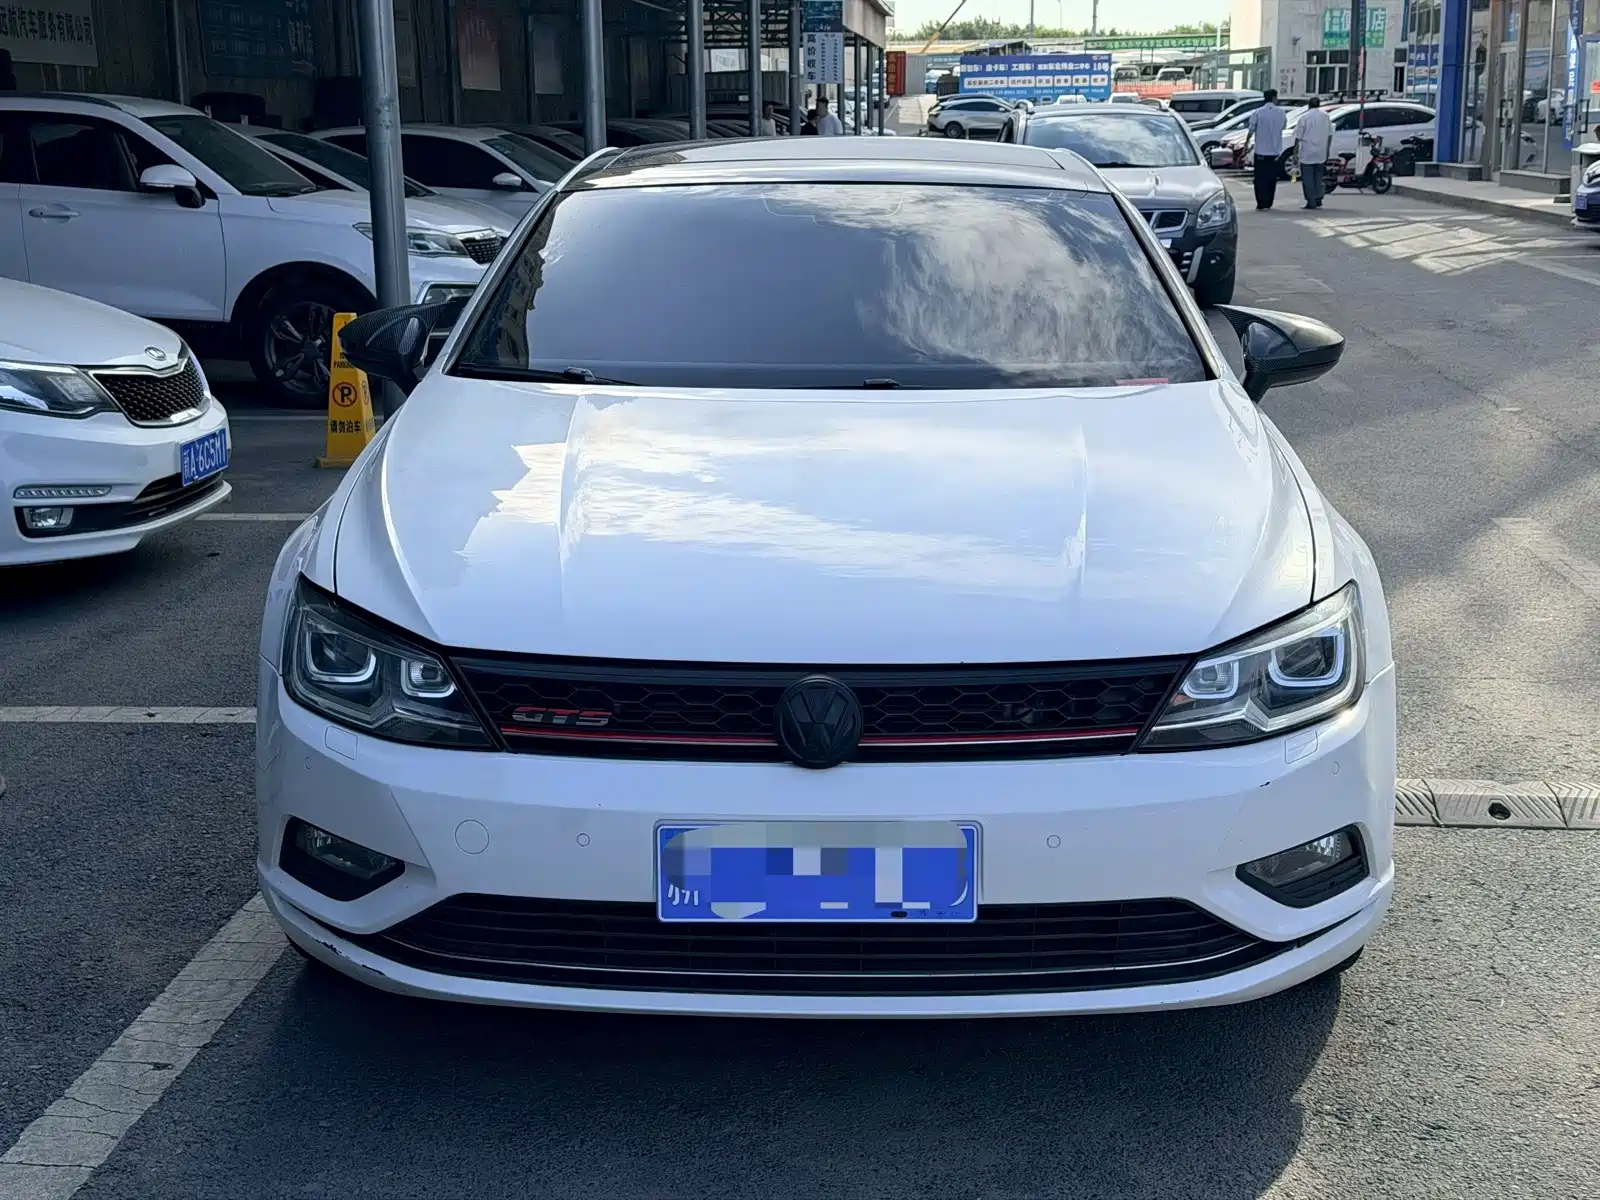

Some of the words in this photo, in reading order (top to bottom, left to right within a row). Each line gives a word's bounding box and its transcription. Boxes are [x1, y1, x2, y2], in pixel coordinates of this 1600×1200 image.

[807, 33, 816, 81] 高价收车
[330, 420, 362, 435] 请勿泊车
